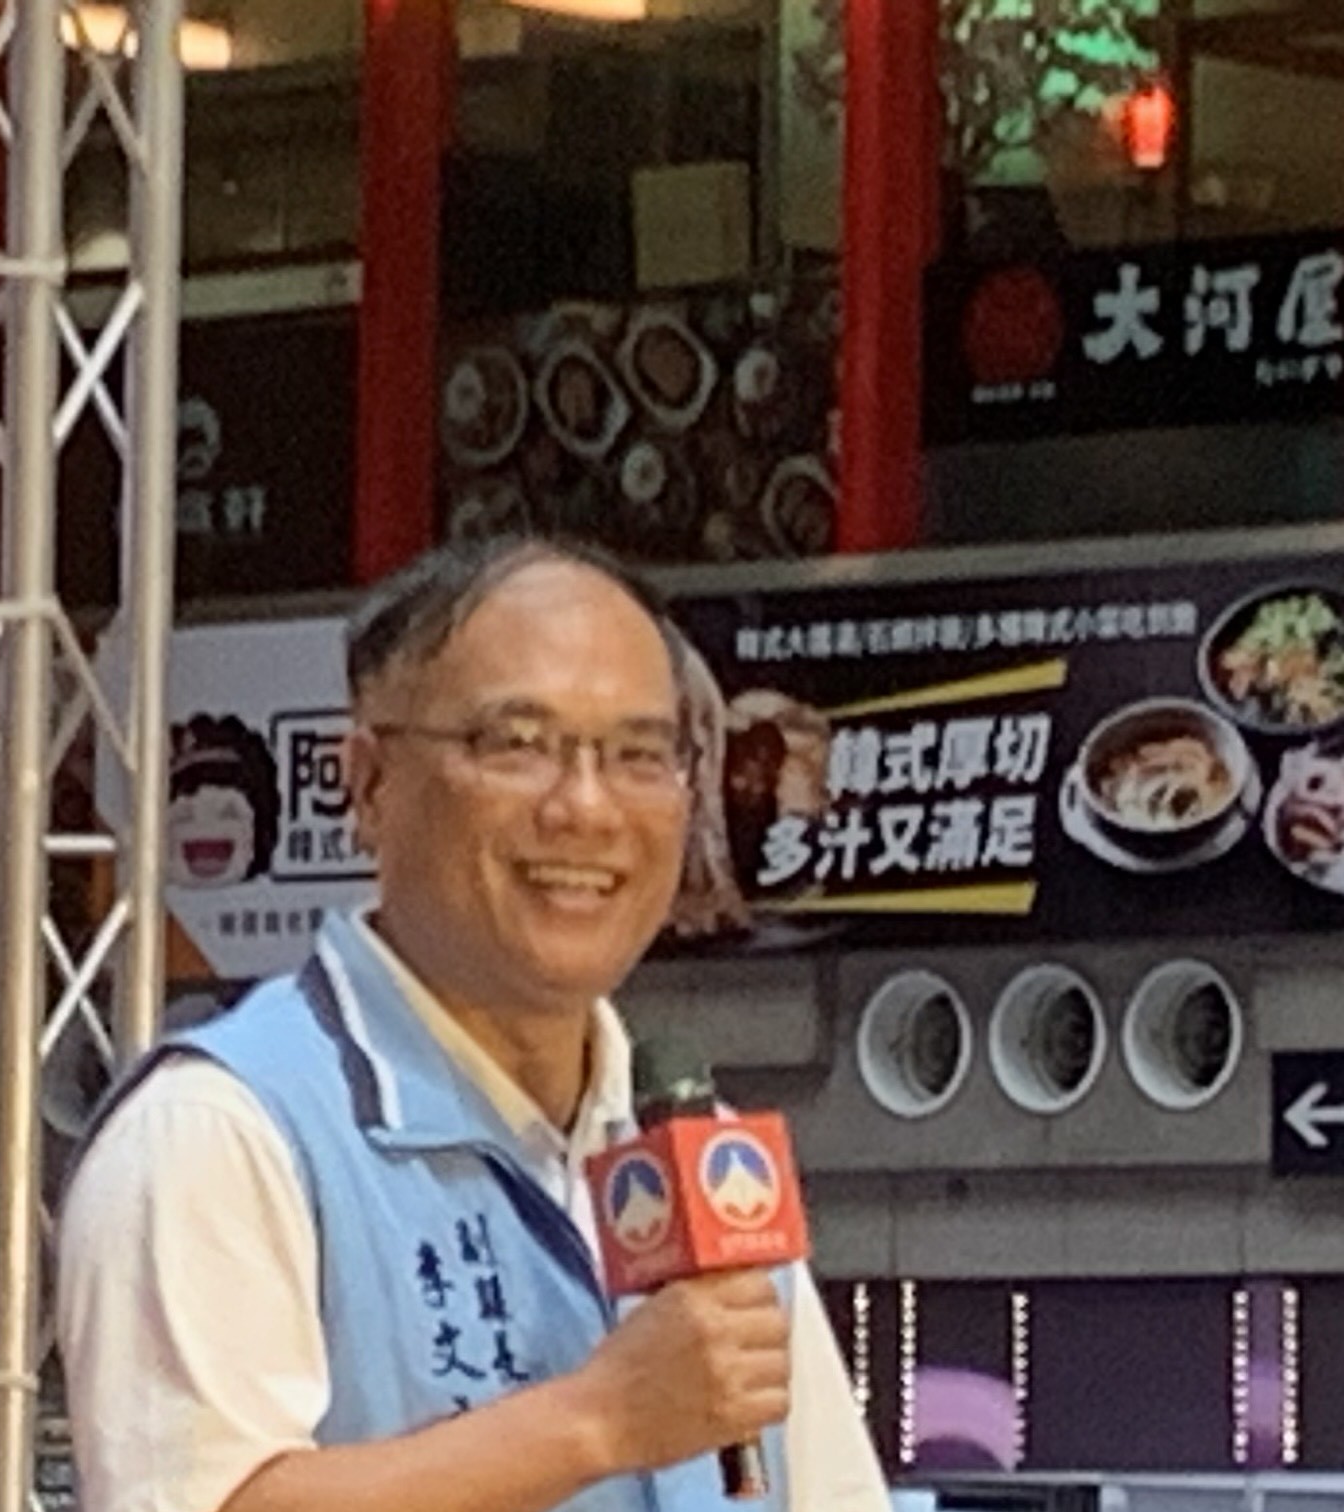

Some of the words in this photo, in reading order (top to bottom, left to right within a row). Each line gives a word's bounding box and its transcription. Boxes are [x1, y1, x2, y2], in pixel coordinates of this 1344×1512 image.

[828, 713, 1052, 798] 韓式厚切
[757, 795, 1038, 887] 多汁又滿足
[415, 1240, 486, 1419] 李文
